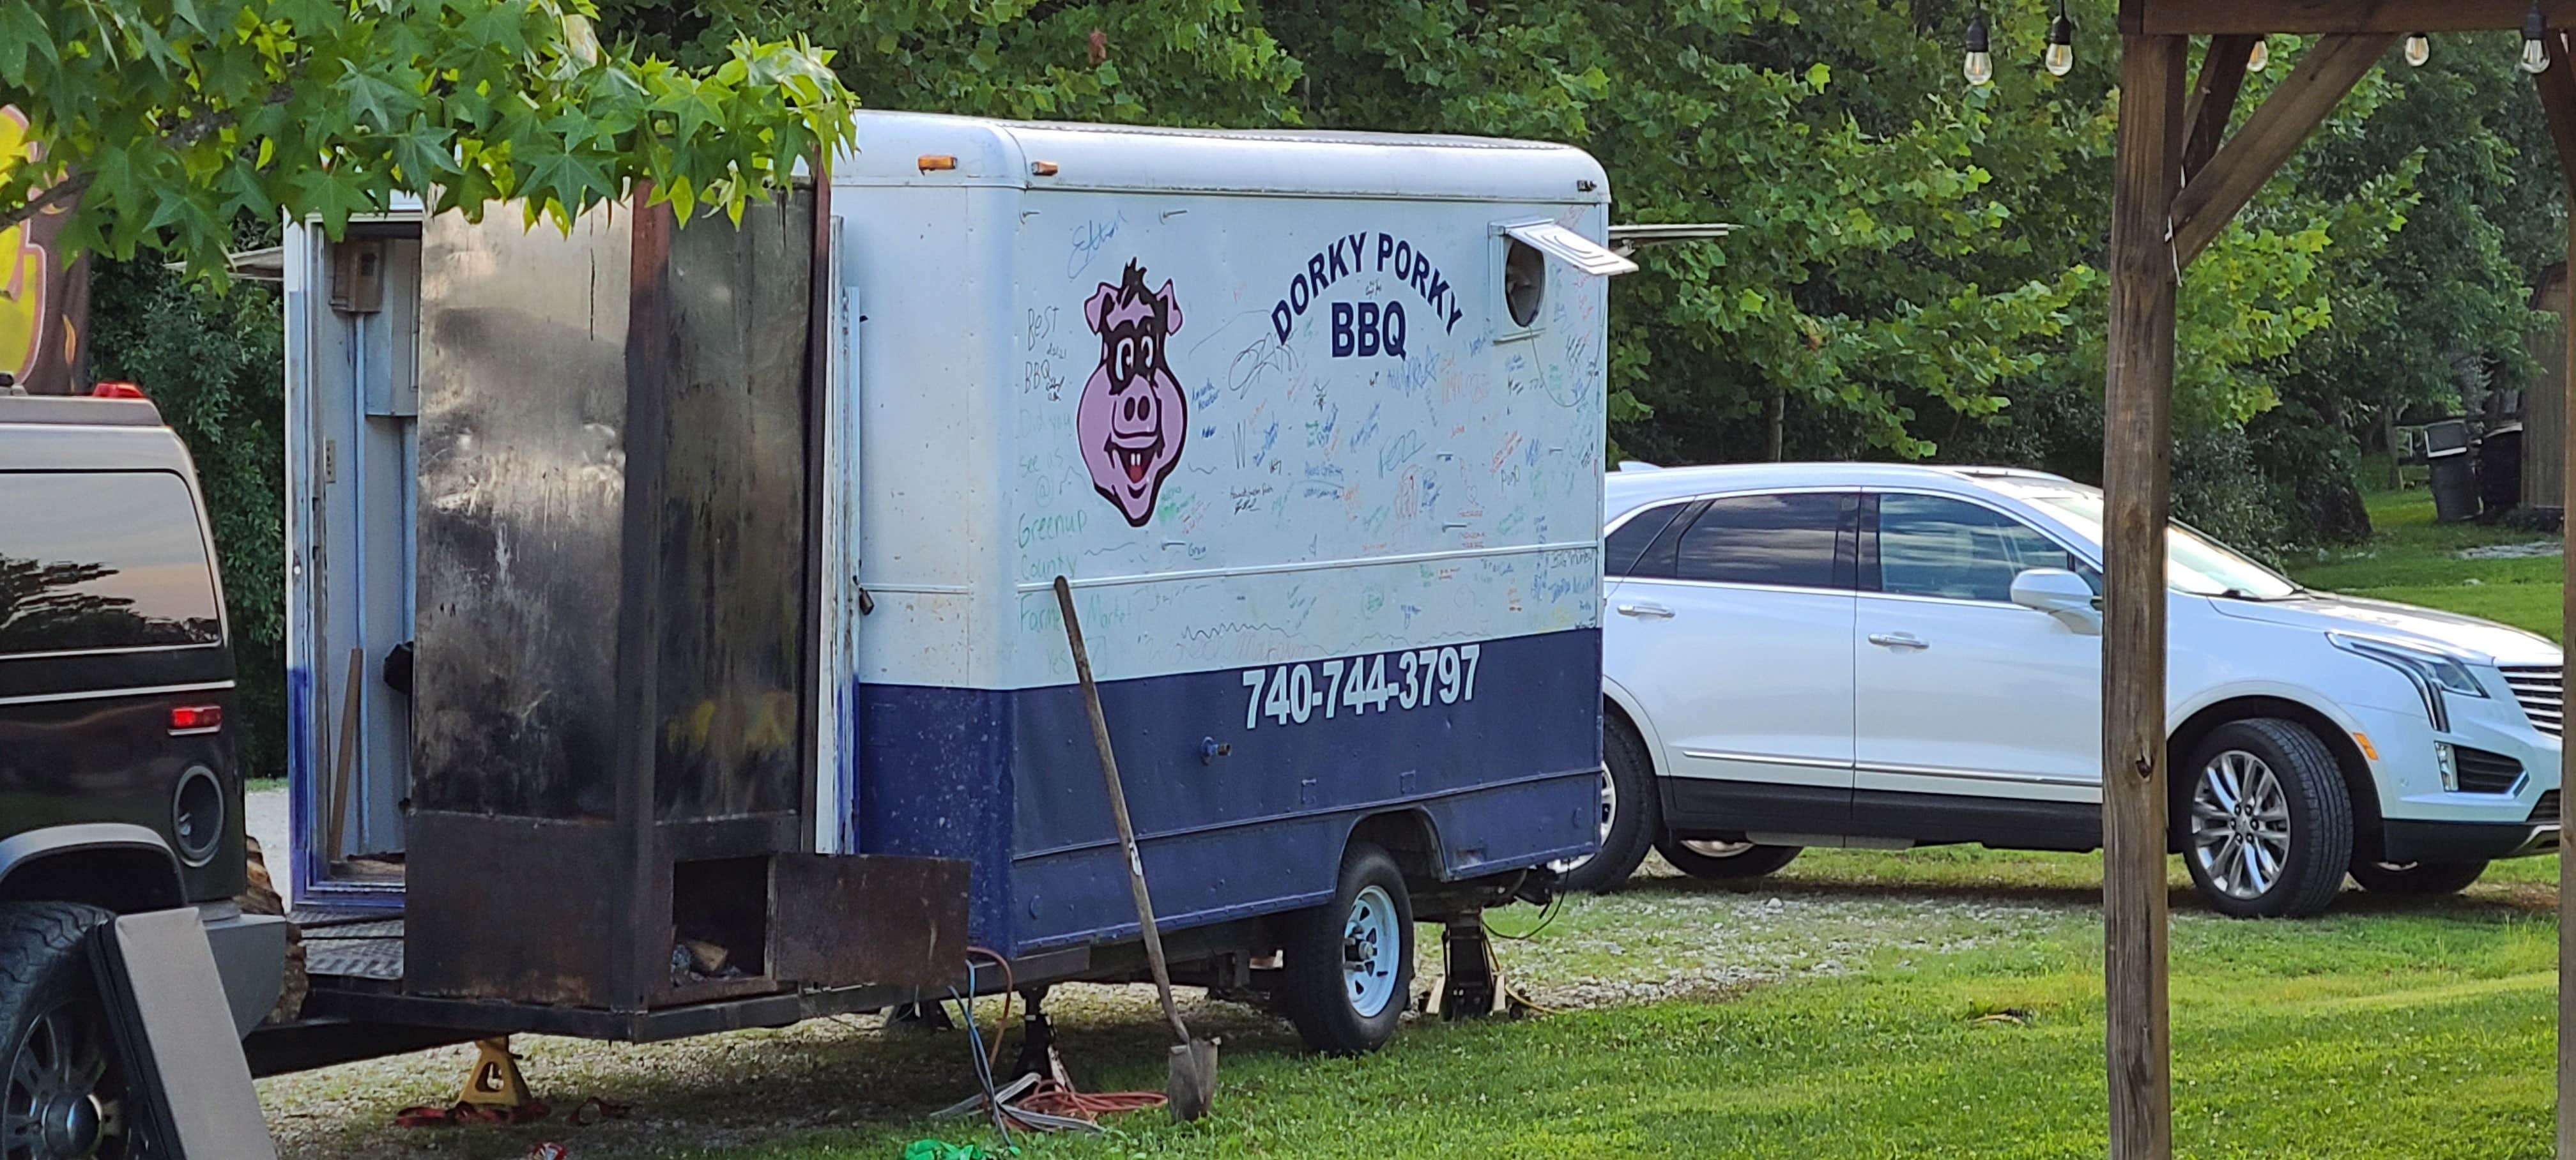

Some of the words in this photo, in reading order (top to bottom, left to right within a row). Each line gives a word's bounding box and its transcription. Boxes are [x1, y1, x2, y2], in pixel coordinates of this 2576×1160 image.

[1271, 232, 1368, 345] DORKY
[1377, 233, 1463, 336] PORKY
[1331, 301, 1407, 362] BBQ
[1017, 510, 1088, 549] Greenup
[1020, 548, 1078, 581] County
[1243, 645, 1483, 729] 740-744-3797
